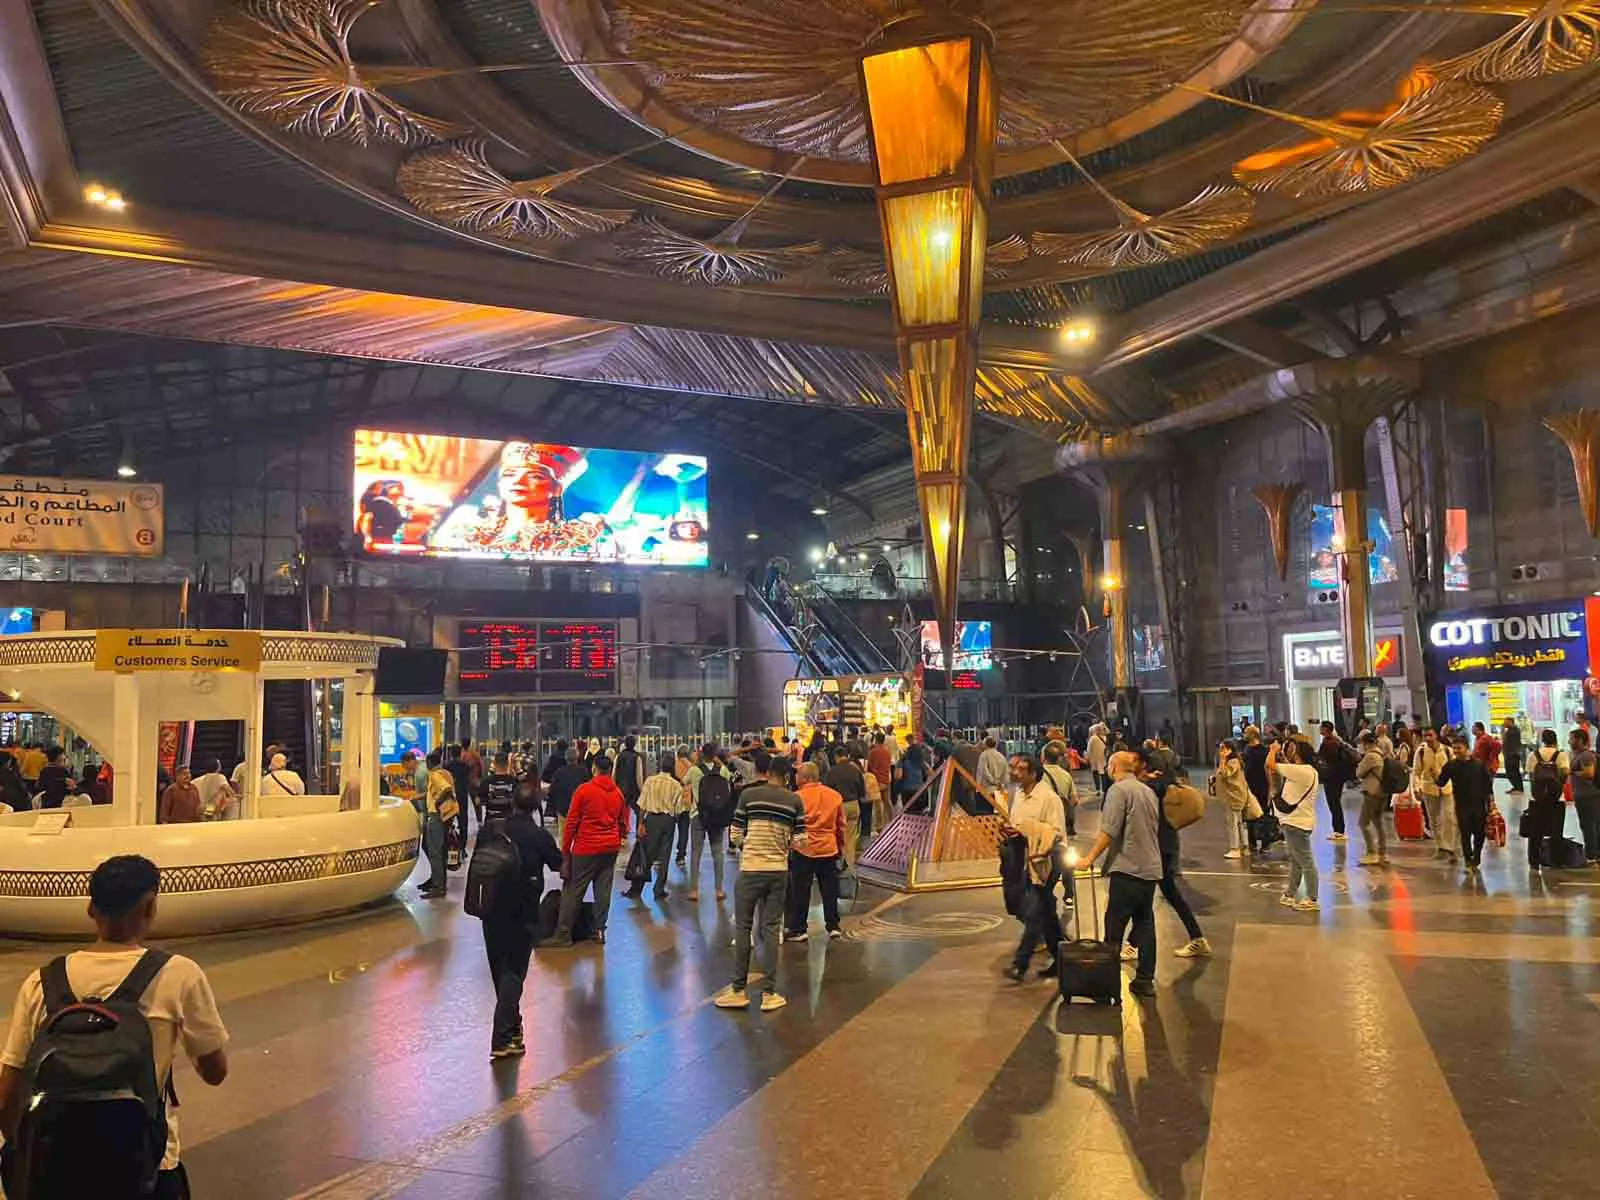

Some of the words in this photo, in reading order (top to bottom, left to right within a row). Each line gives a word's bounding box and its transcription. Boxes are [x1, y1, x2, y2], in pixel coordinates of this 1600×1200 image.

[29, 499, 39, 511] و
[44, 499, 125, 513] المطاعم
[25, 512, 84, 527] Court
[127, 635, 181, 647] العملاء
[184, 635, 229, 648] خدمة
[114, 655, 187, 667] Customers
[191, 655, 240, 667] Service
